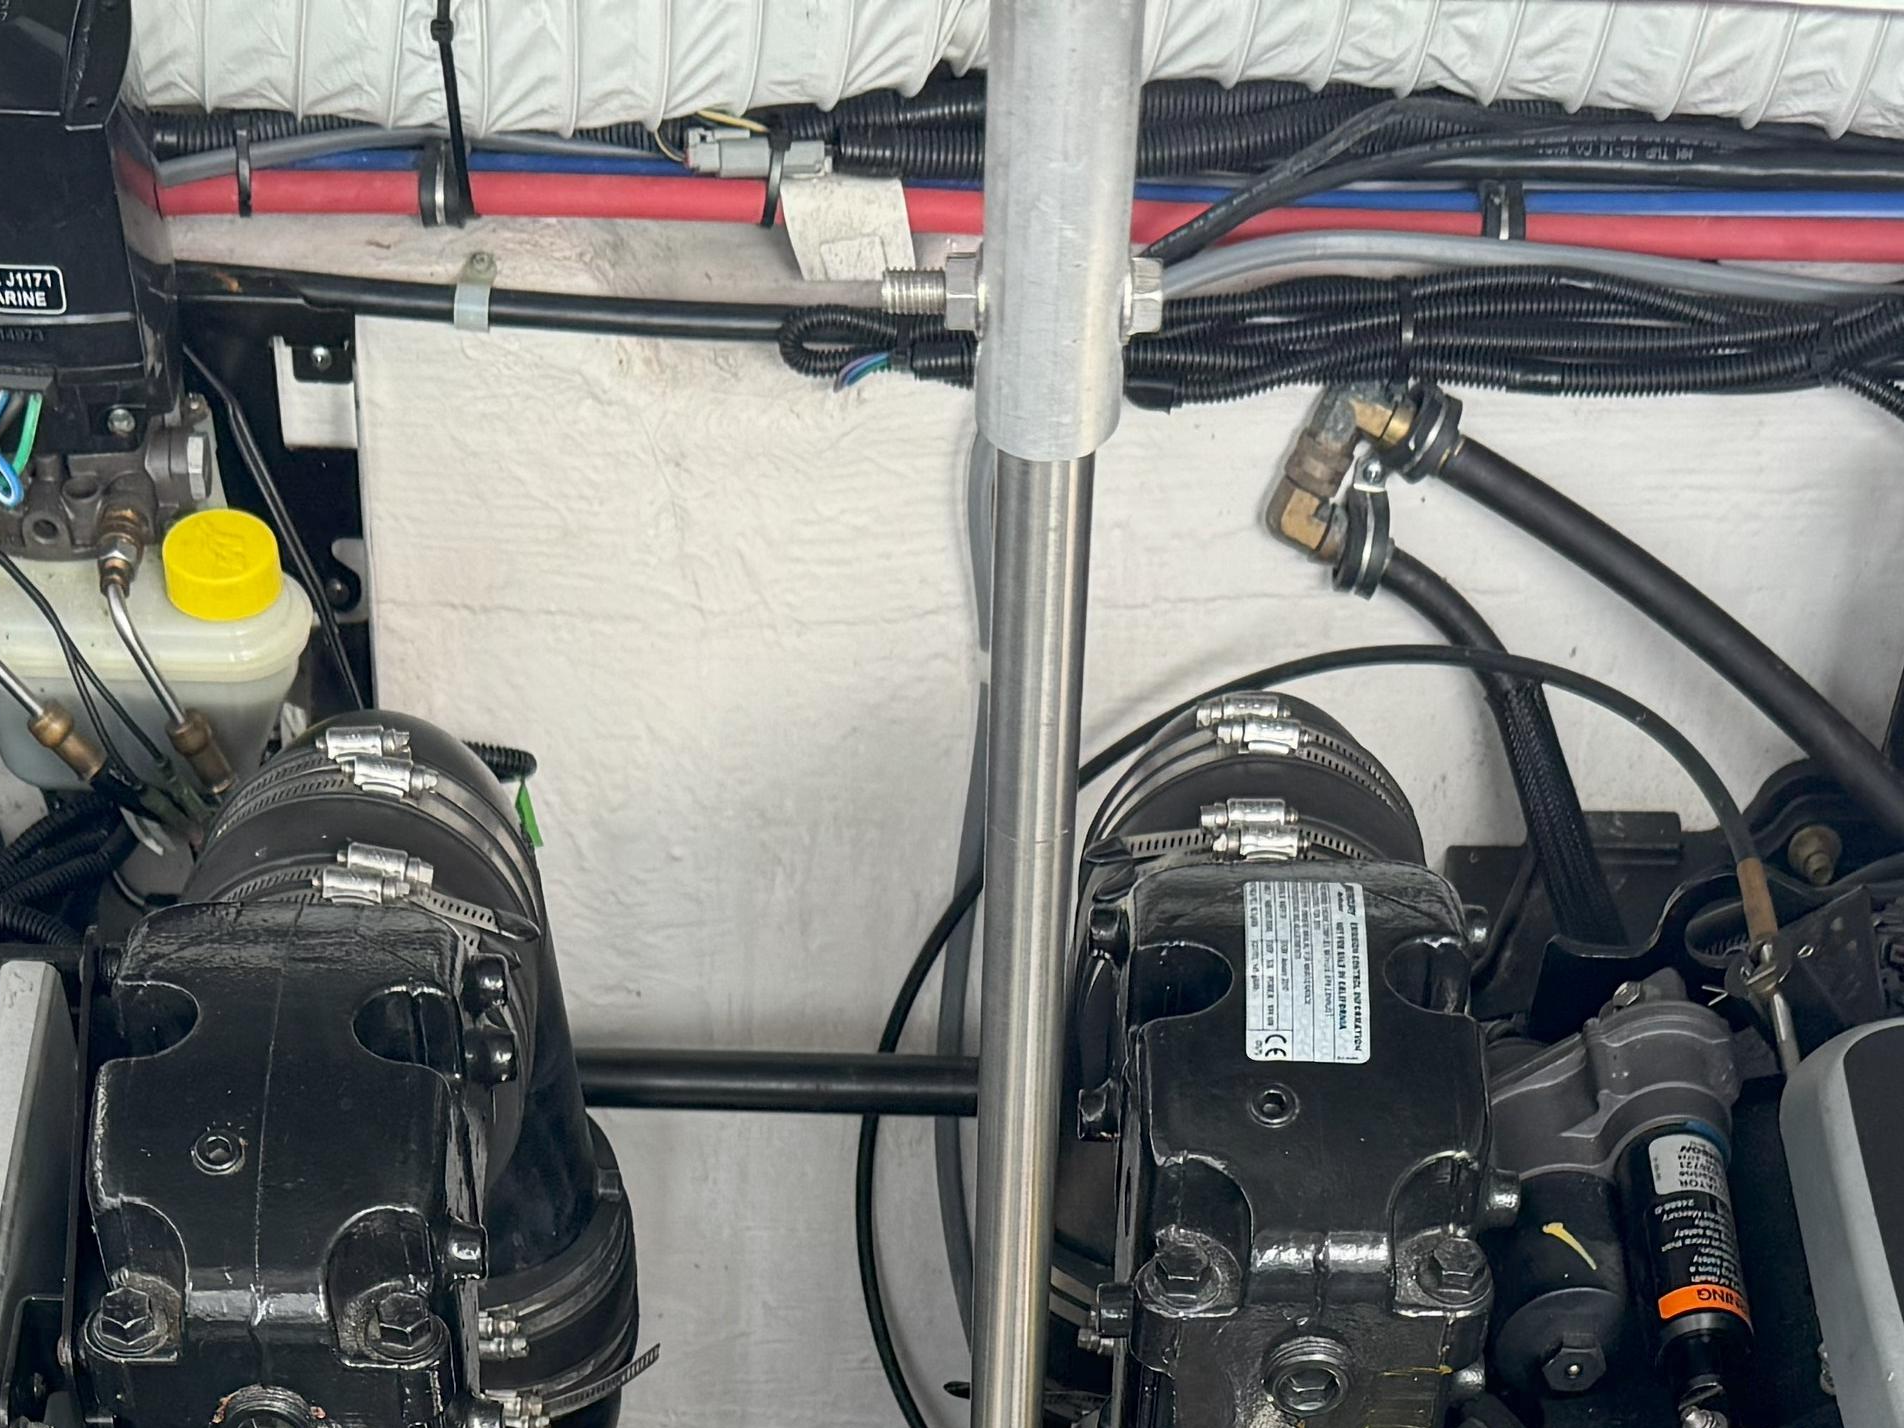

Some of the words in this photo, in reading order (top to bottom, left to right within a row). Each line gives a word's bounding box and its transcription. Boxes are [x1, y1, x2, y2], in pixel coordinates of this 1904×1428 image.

[5, 271, 52, 288] J1171
[1337, 980, 1347, 1030] CALIFORNIA
[1353, 991, 1363, 1052] INFORMATION
